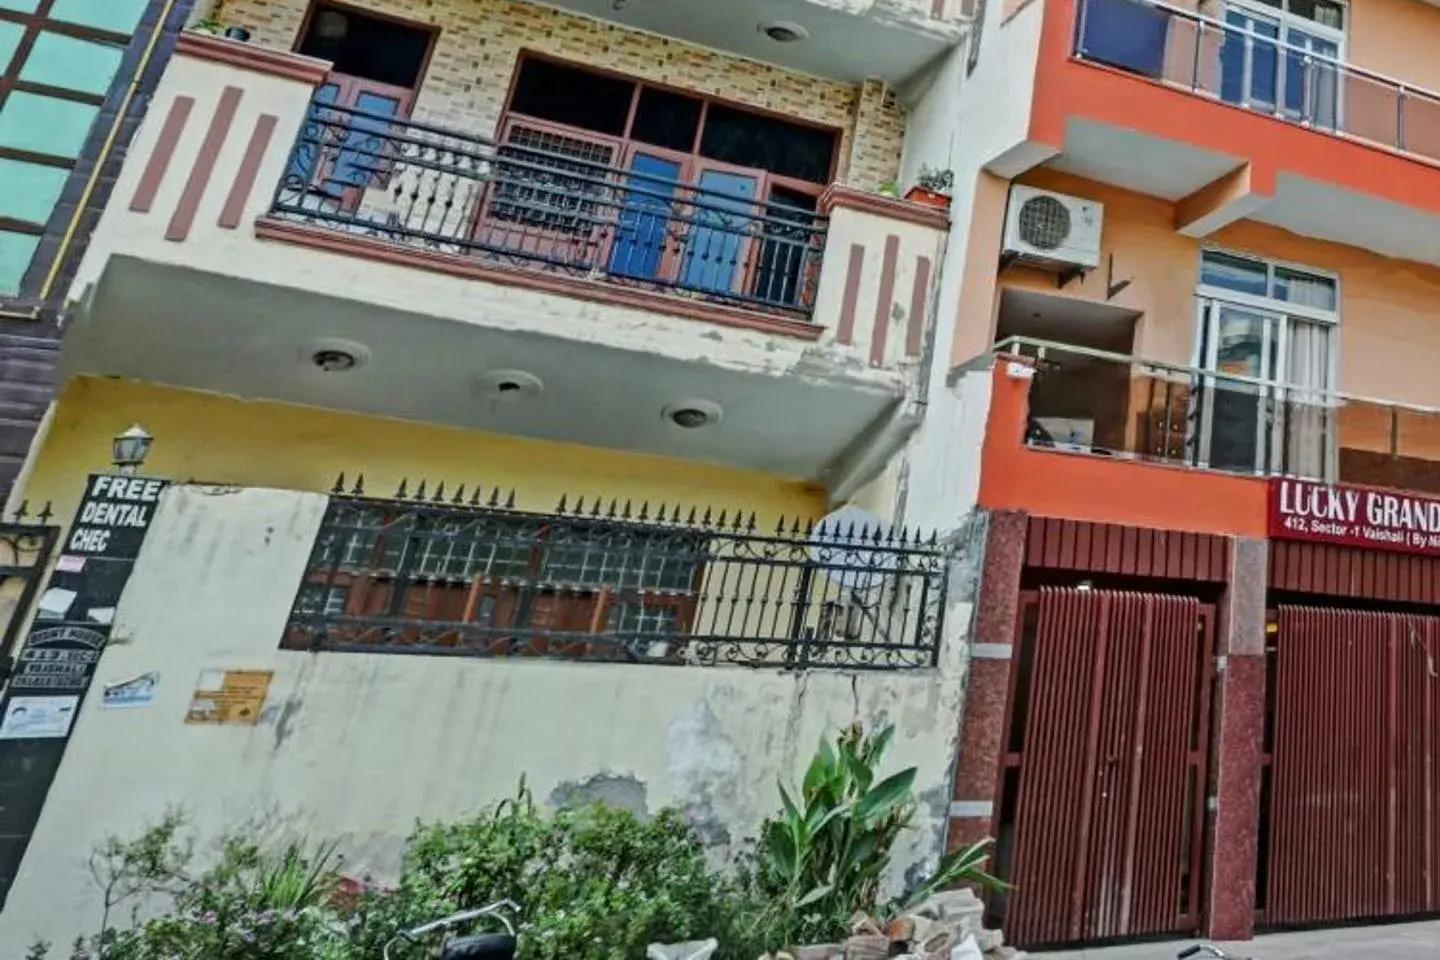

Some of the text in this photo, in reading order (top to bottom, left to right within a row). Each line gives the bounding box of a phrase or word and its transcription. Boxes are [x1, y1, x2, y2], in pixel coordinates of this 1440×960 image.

[91, 476, 162, 501] FREE
[1280, 481, 1360, 522] LUCKY
[80, 501, 147, 527] DENTAL
[69, 527, 111, 552] CHEC
[1284, 516, 1309, 533] 412,
[1310, 519, 1347, 537] Sector
[1362, 525, 1404, 543] Vaishali
